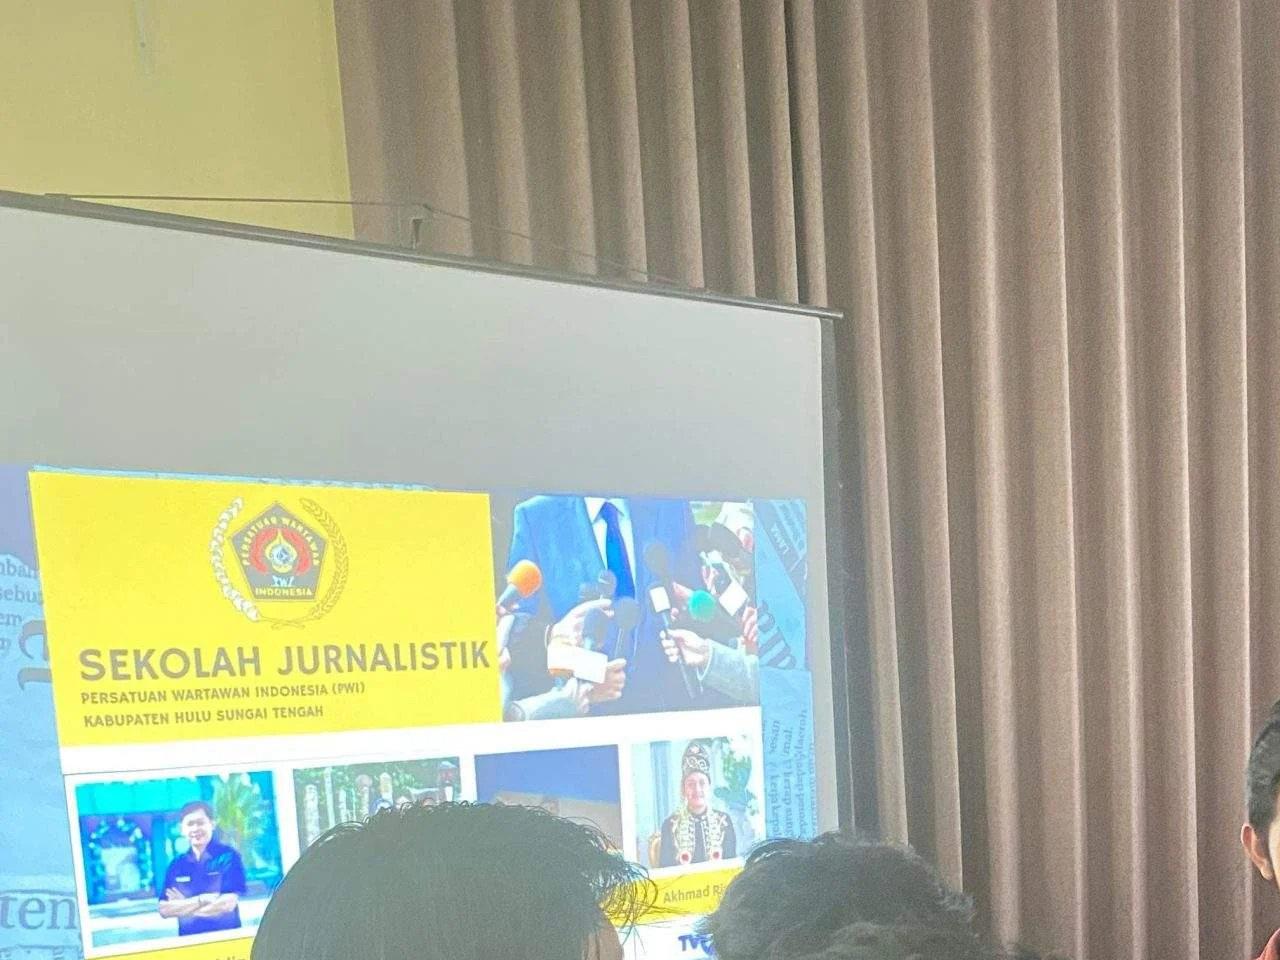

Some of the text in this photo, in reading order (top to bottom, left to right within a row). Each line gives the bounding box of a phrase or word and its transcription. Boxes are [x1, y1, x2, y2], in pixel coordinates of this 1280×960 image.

[255, 587, 313, 597] INDONESIA
[79, 645, 262, 681] SEKOLAH
[277, 640, 490, 677] JURNALISTIK
[80, 681, 365, 704] PERSATUAN WARTAWAN INDONESIA (PWI)
[83, 705, 324, 728] KABUPATEN HULU SUNGAI TENGAH
[663, 884, 710, 904] Akhmad
